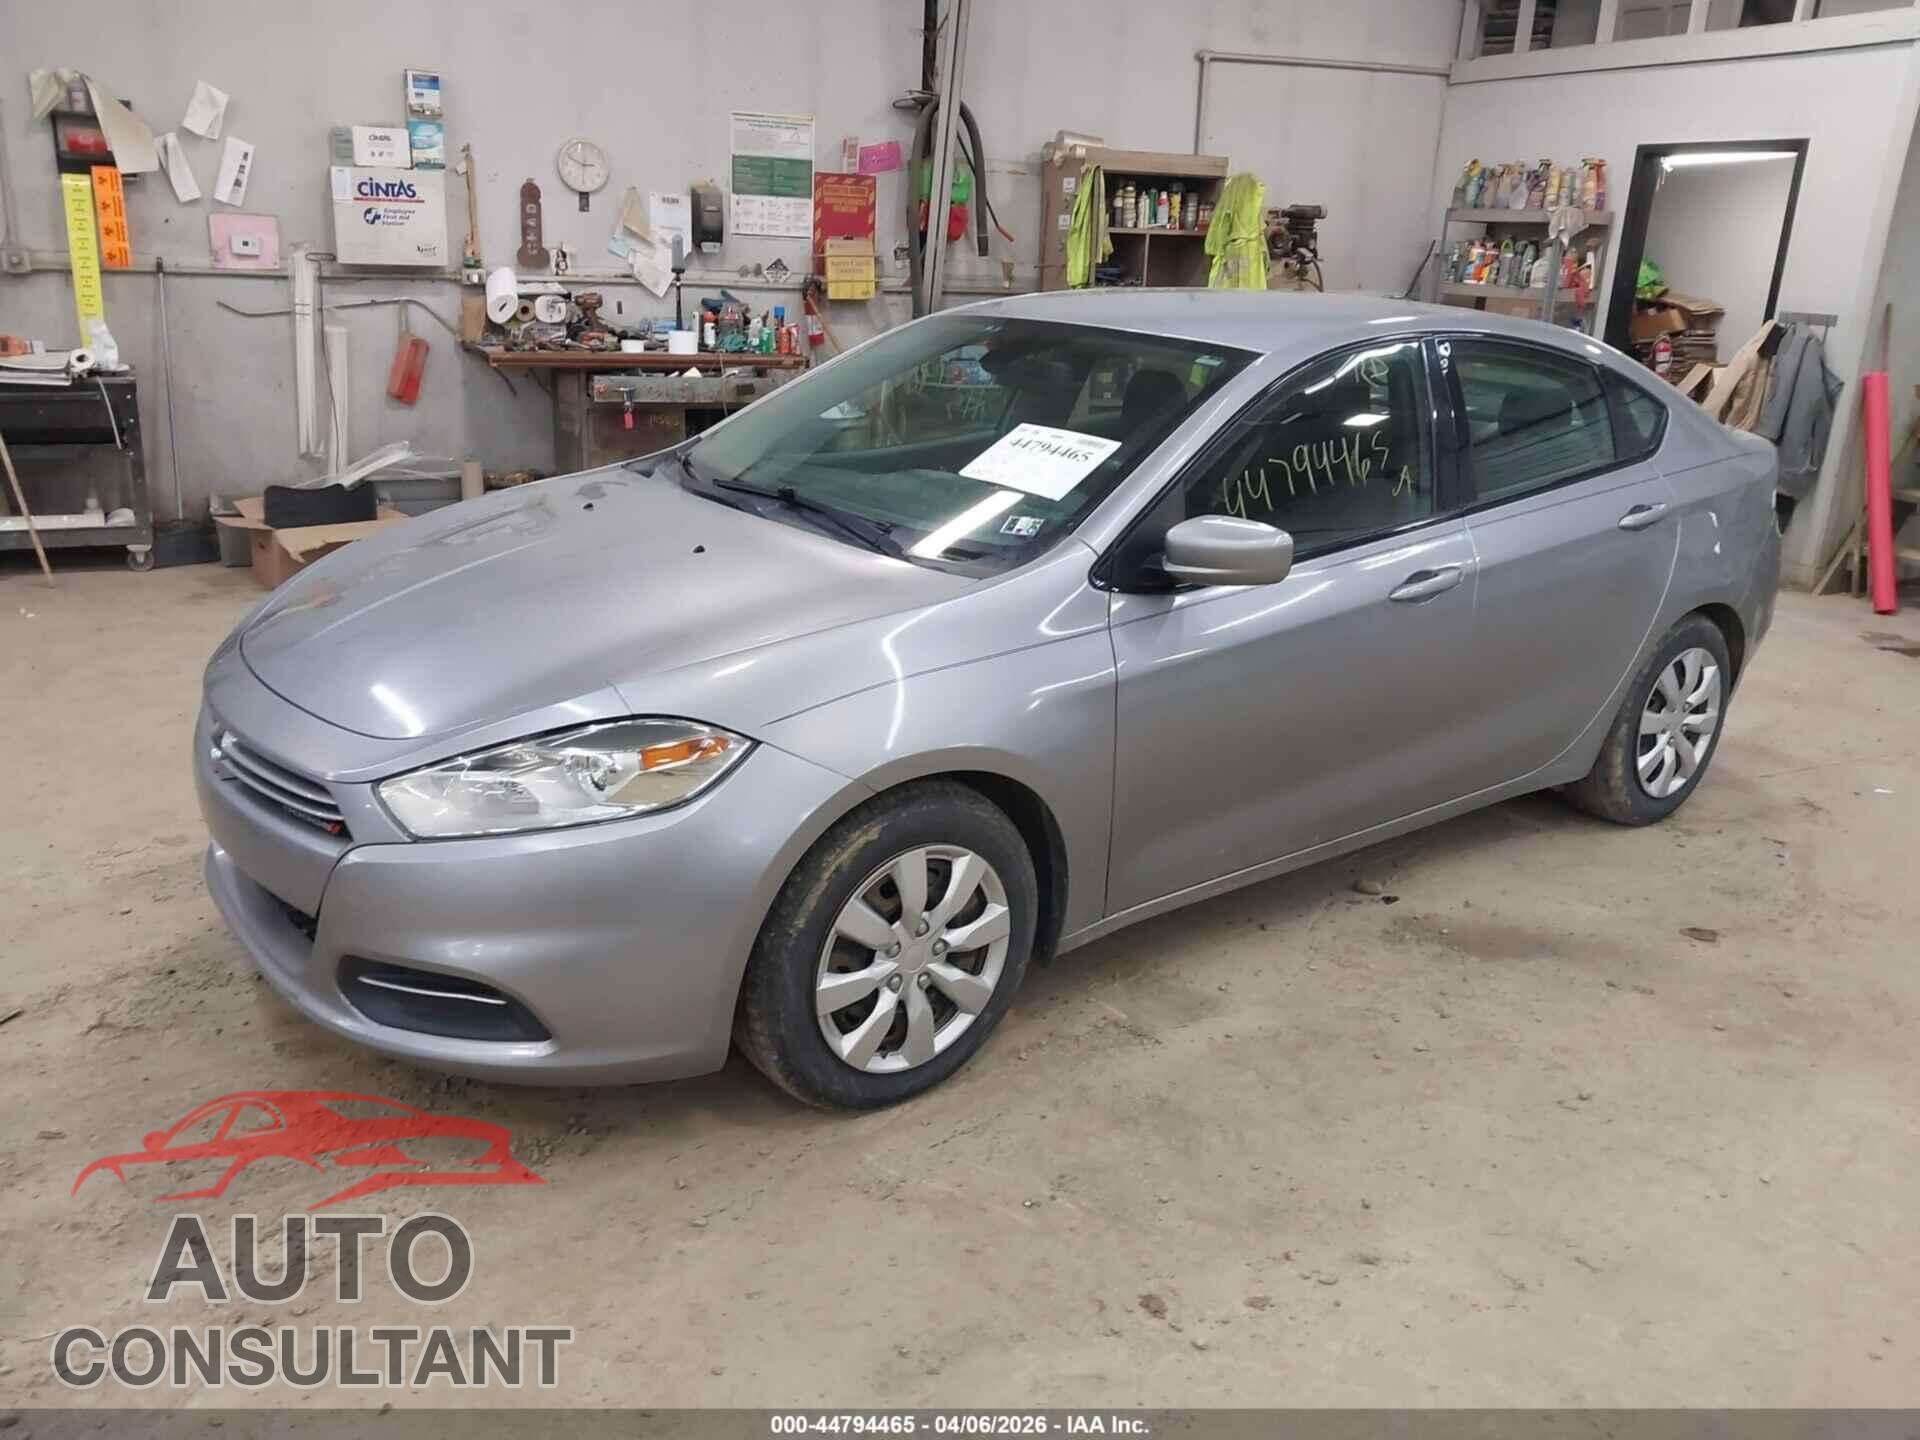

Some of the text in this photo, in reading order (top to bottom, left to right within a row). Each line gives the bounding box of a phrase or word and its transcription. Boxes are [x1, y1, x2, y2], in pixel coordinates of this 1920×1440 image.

[356, 177, 417, 198] CINTAS
[1009, 437, 1094, 463] 44794465
[1223, 430, 1390, 520] 44794465
